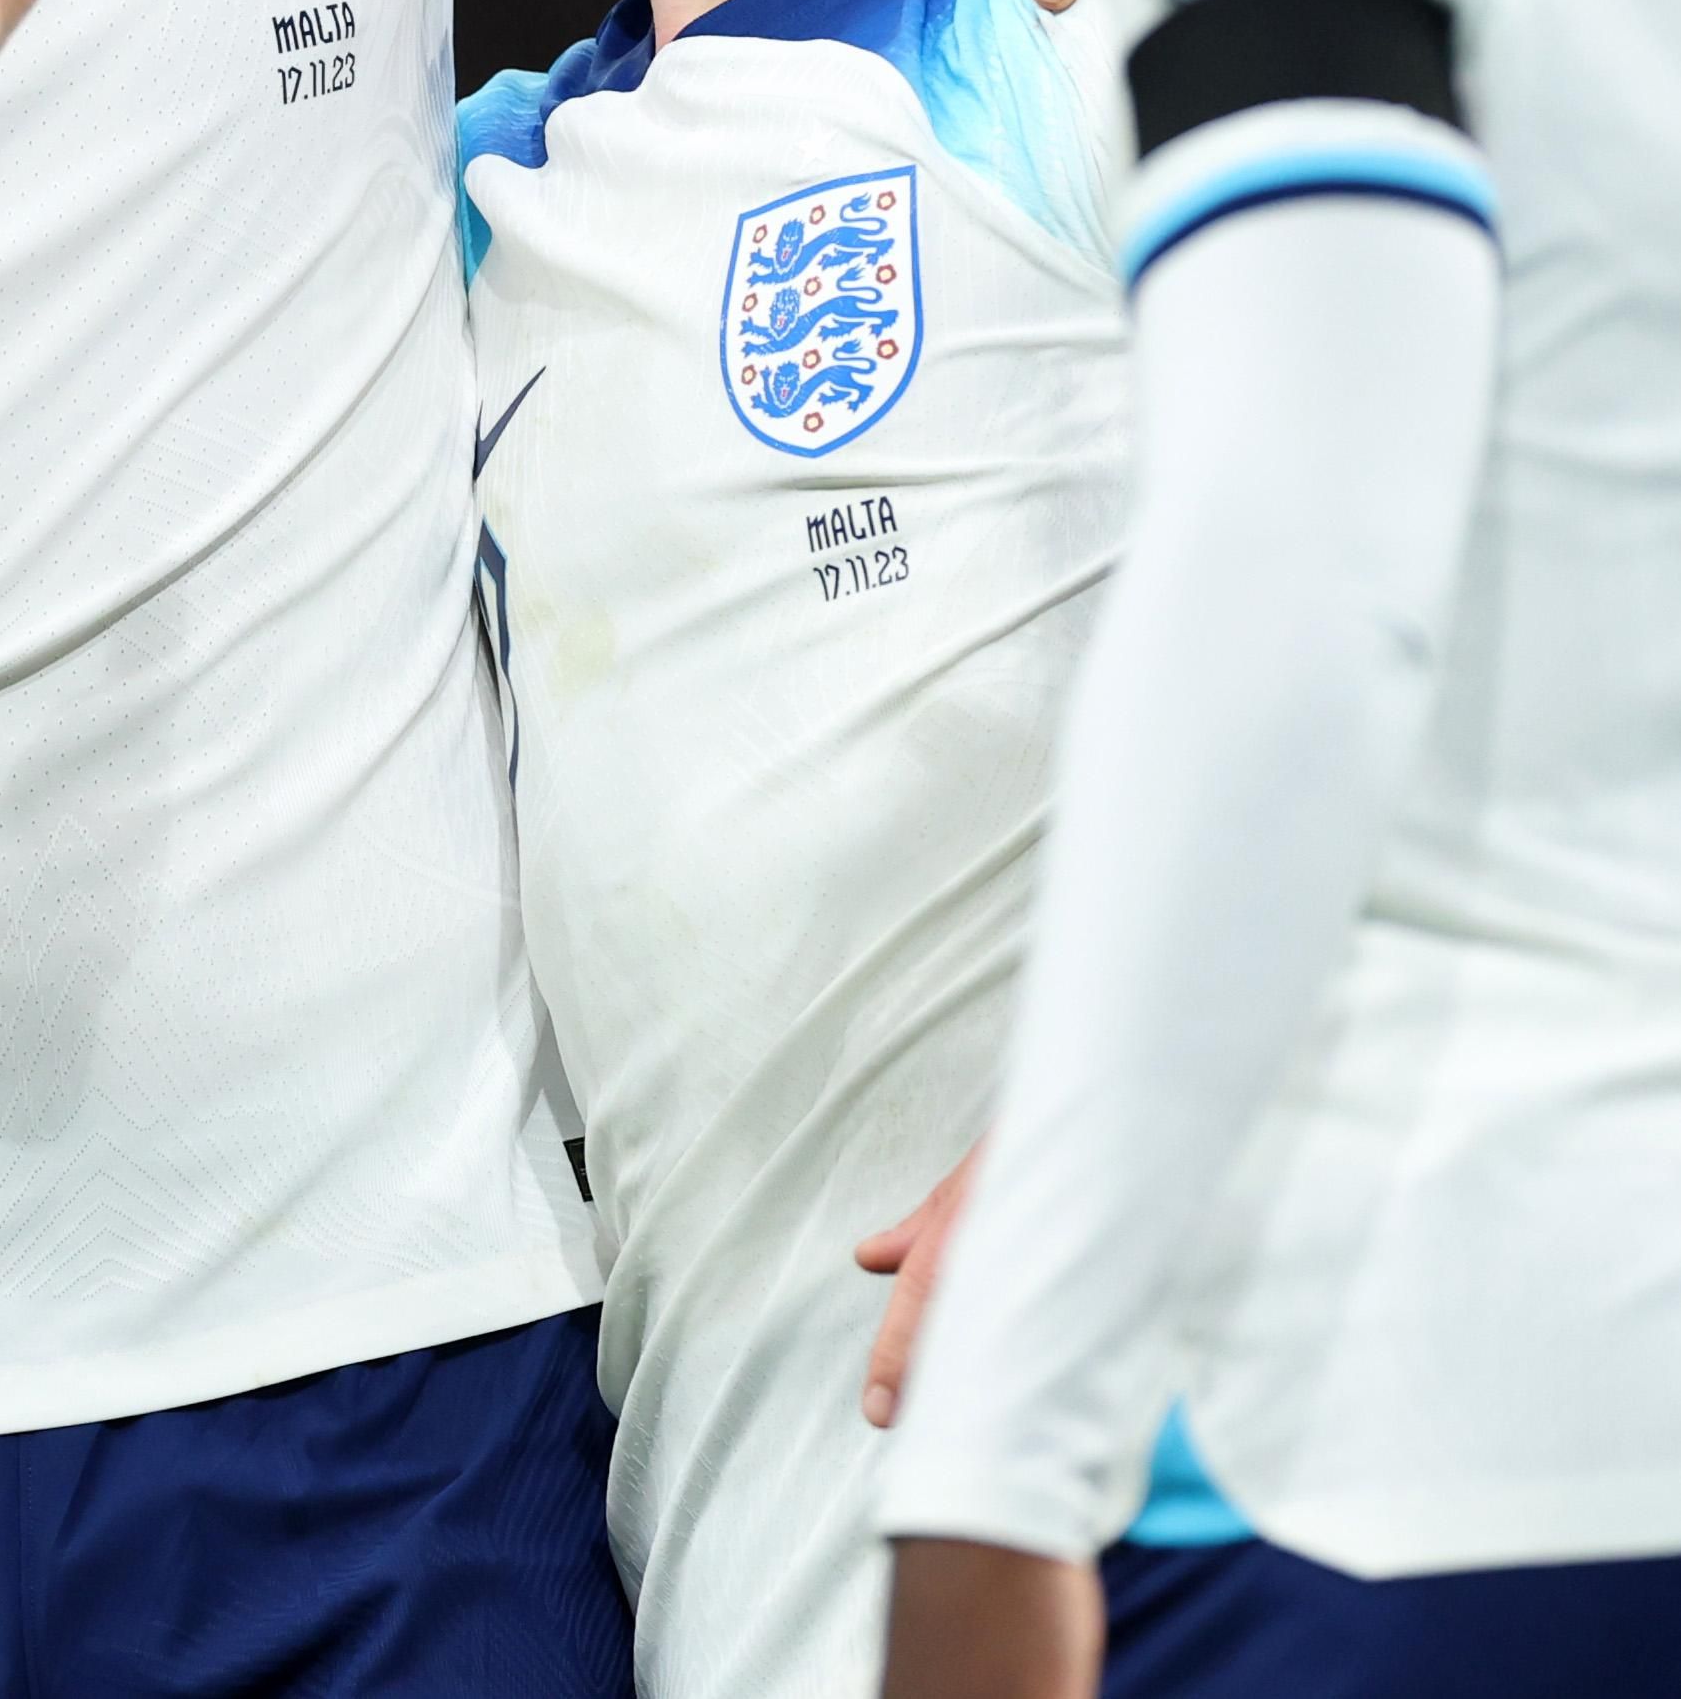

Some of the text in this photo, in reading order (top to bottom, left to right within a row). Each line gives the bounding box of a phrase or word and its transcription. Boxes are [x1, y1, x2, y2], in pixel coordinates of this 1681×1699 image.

[272, 1, 356, 54] MALTA
[277, 52, 356, 105] 17.11.23
[806, 496, 898, 553] MALTA
[813, 546, 909, 602] 17.11.23
